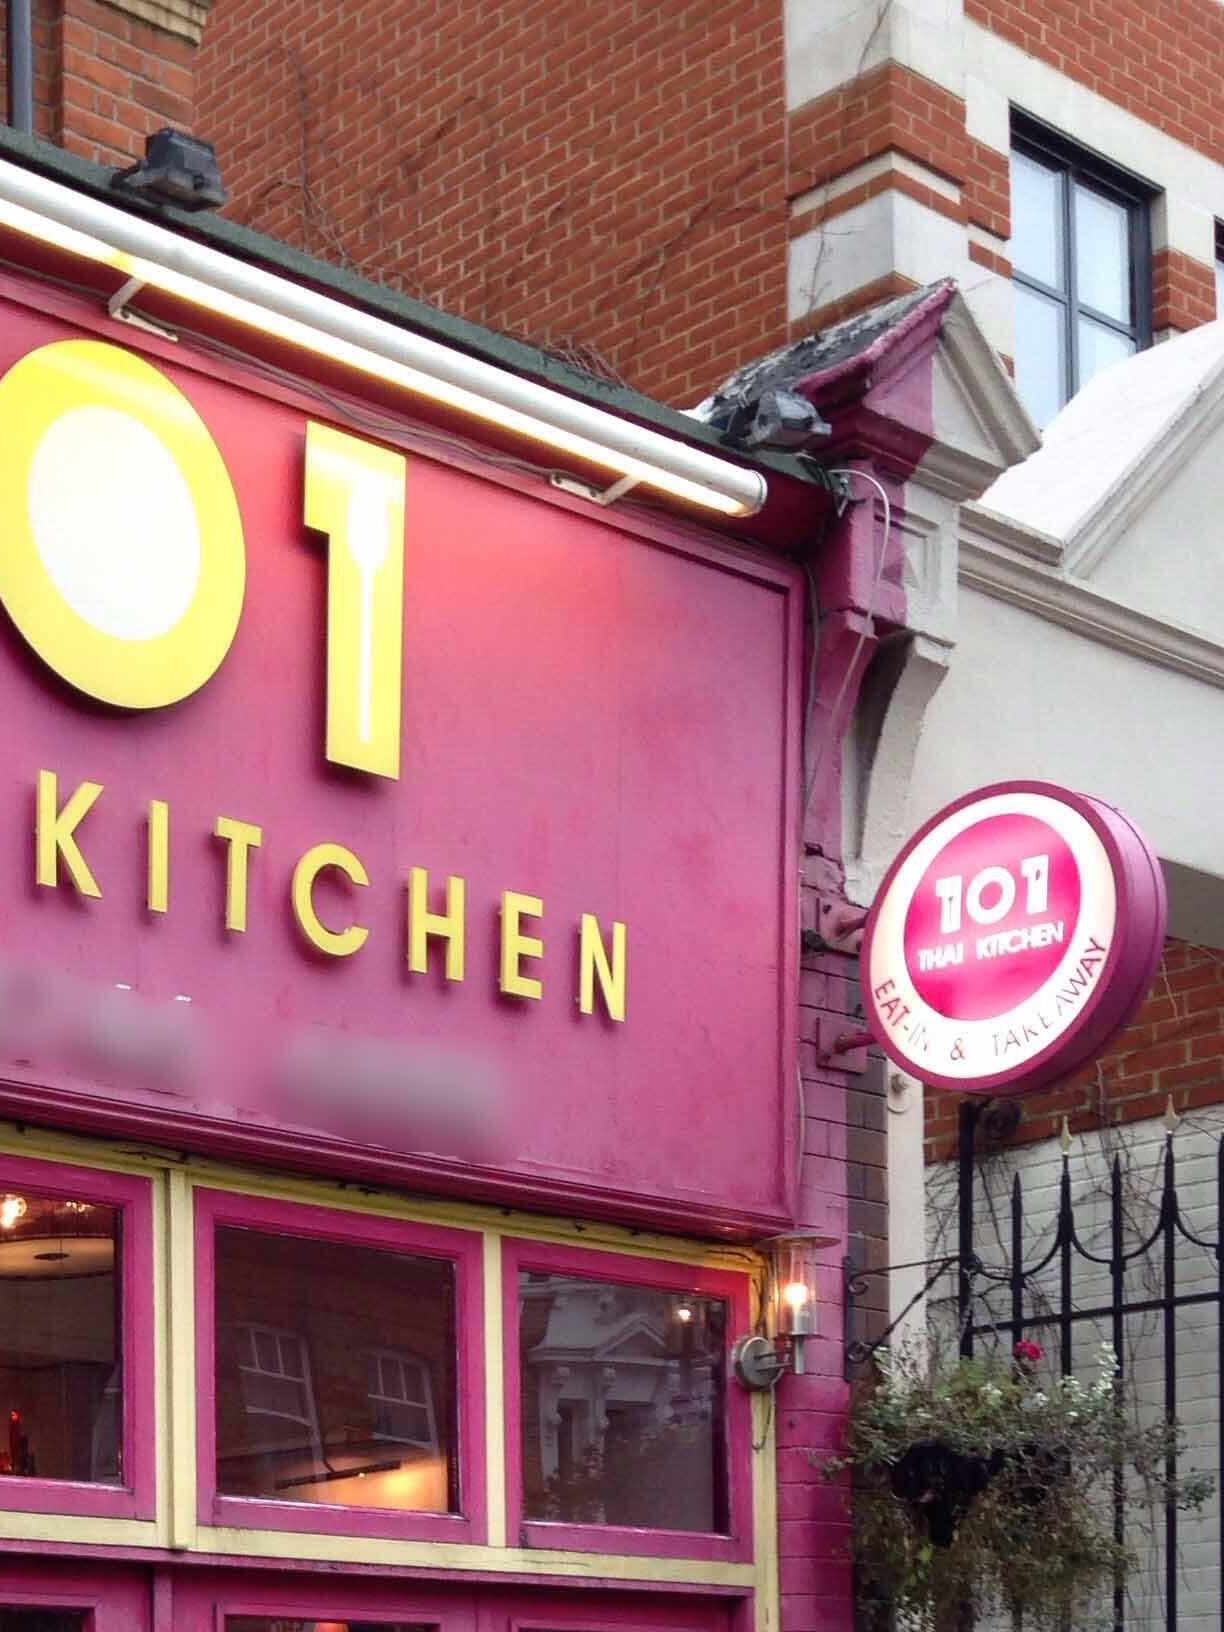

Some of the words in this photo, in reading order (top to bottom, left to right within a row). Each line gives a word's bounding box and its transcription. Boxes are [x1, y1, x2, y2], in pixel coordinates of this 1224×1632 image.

[35, 769, 626, 1022] KITCHEN
[935, 854, 1049, 934] 101
[917, 943, 964, 971] THAI
[975, 921, 1064, 960] KITCHEN
[949, 1037, 966, 1062] &
